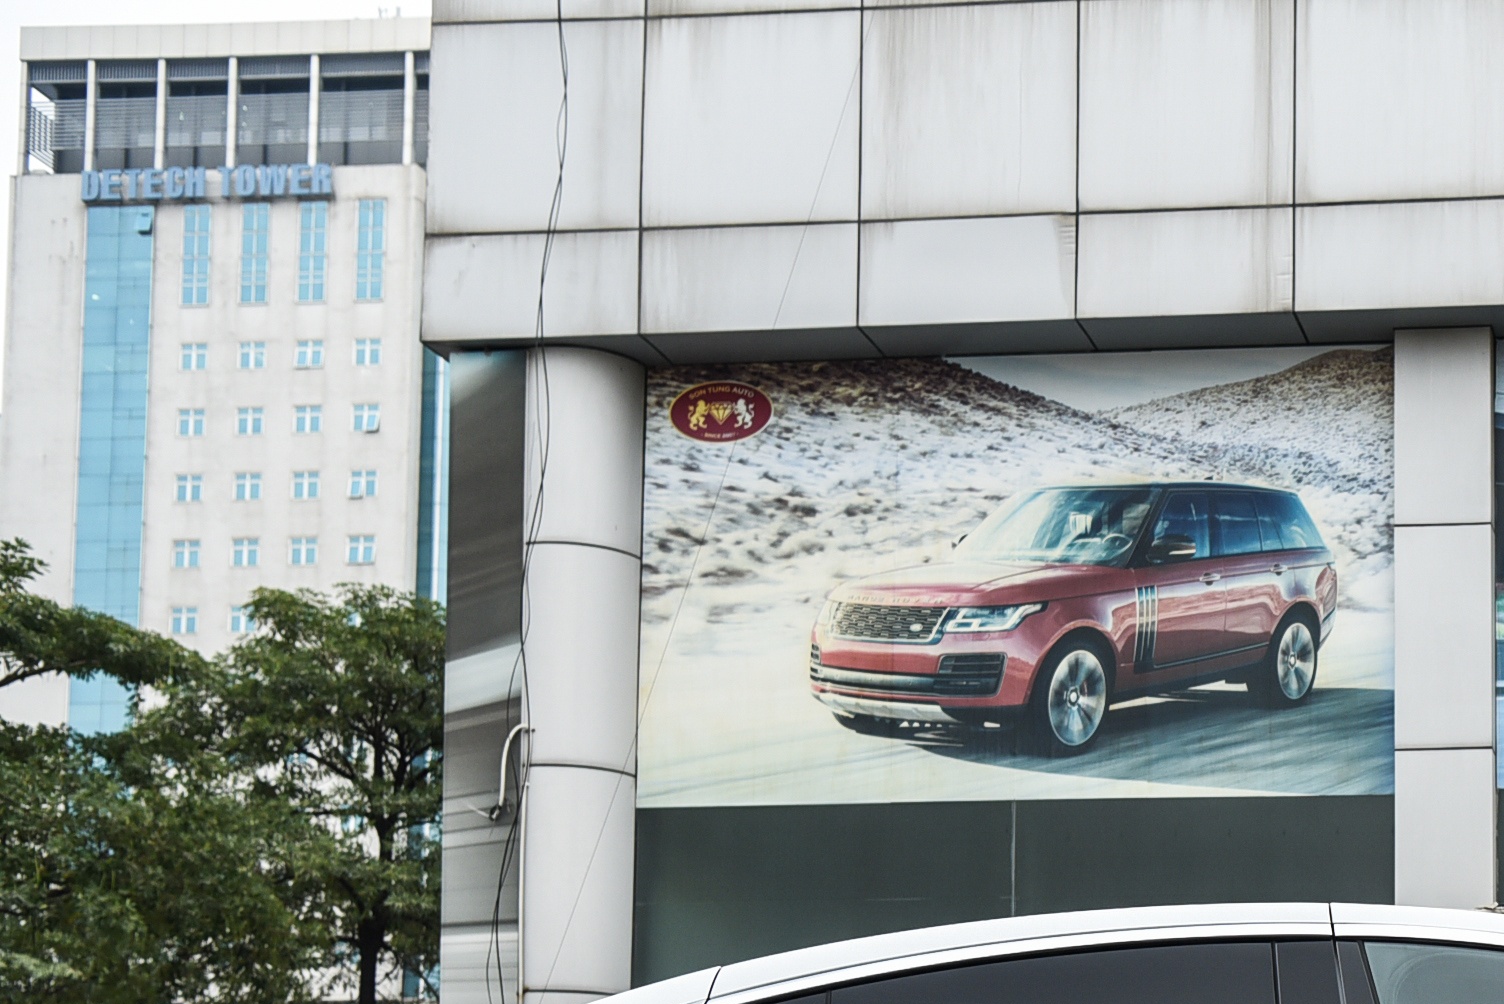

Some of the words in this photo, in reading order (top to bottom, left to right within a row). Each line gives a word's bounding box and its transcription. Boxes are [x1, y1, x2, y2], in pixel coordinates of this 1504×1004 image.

[81, 166, 206, 201] DETECH
[217, 163, 333, 198] TOWER
[731, 387, 755, 398] AUTO
